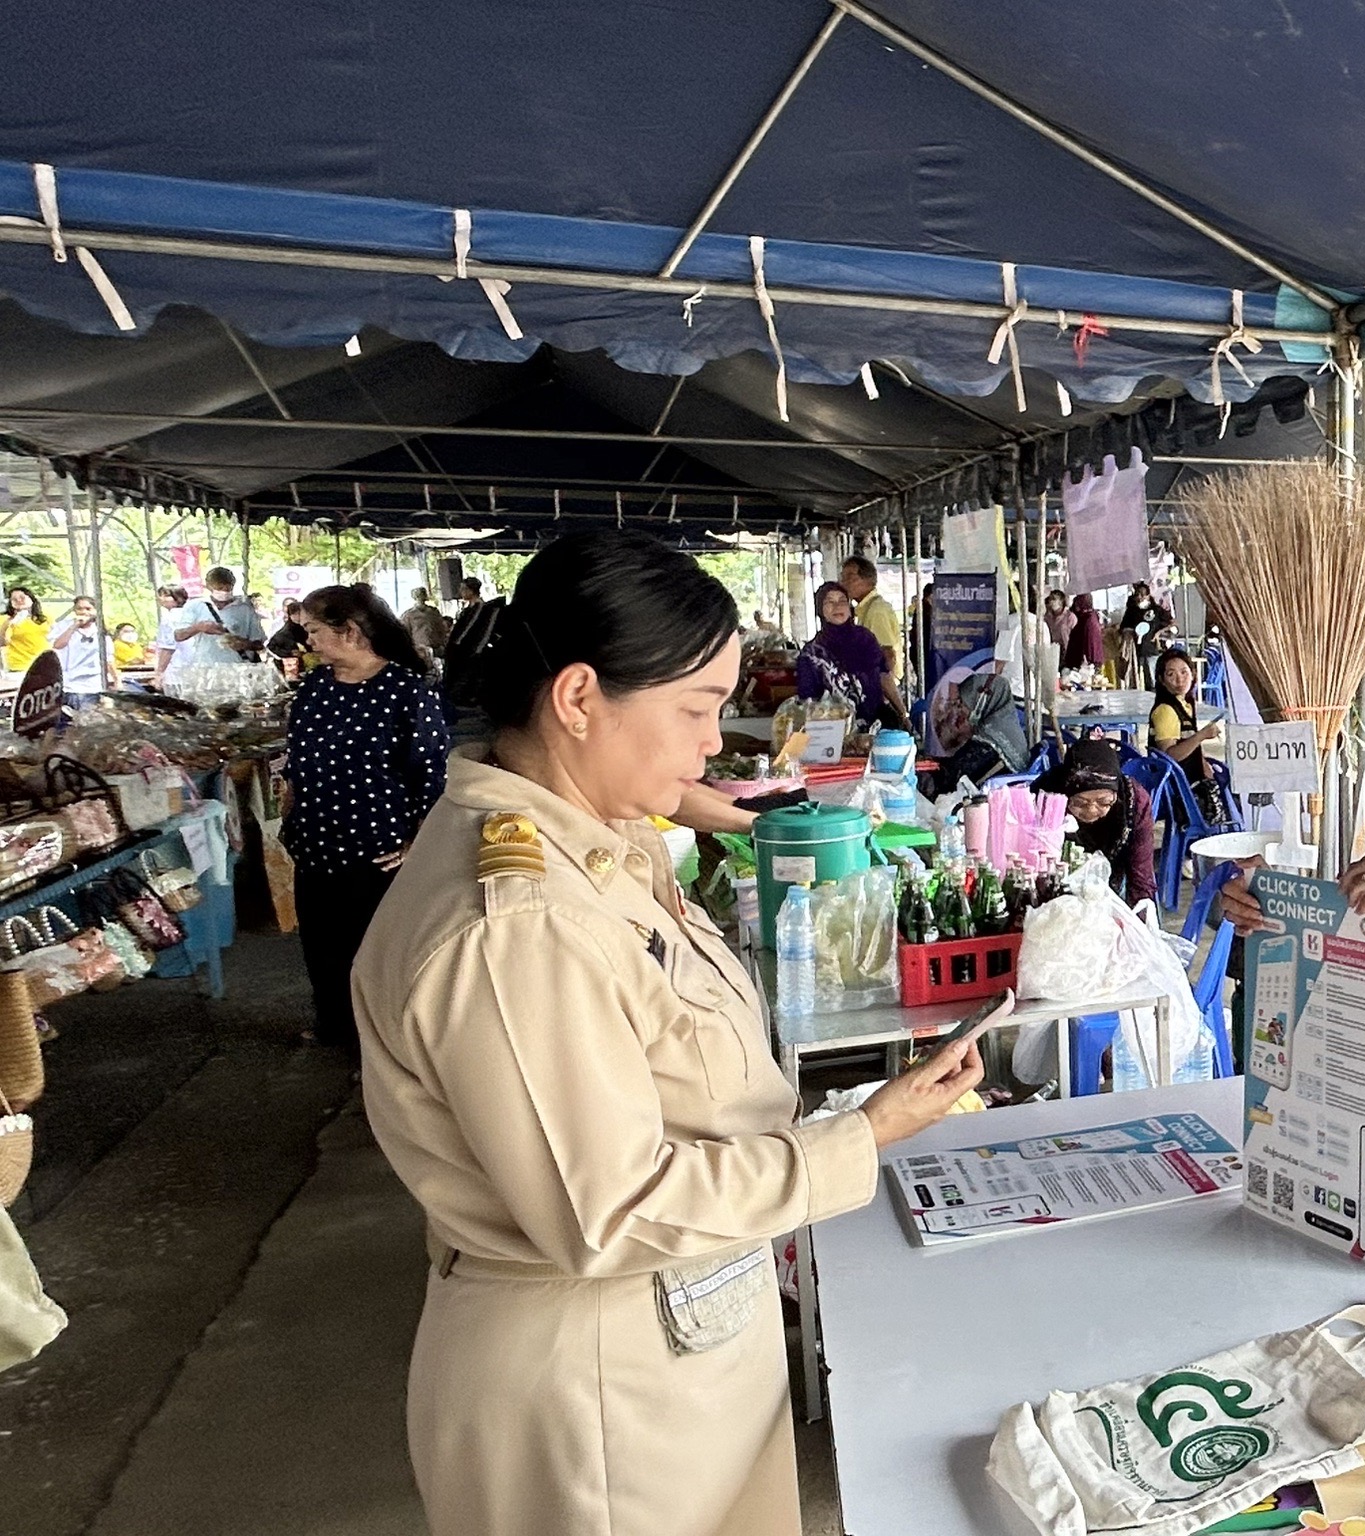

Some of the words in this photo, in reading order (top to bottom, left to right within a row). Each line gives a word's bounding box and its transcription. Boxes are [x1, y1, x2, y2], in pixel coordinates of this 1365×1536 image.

[19, 682, 61, 719] OTOP
[1236, 740, 1258, 760] 80
[1266, 740, 1307, 761] บาท
[1257, 875, 1298, 899] CLICK
[1300, 883, 1321, 902] TO
[1267, 897, 1337, 927] CONNECT
